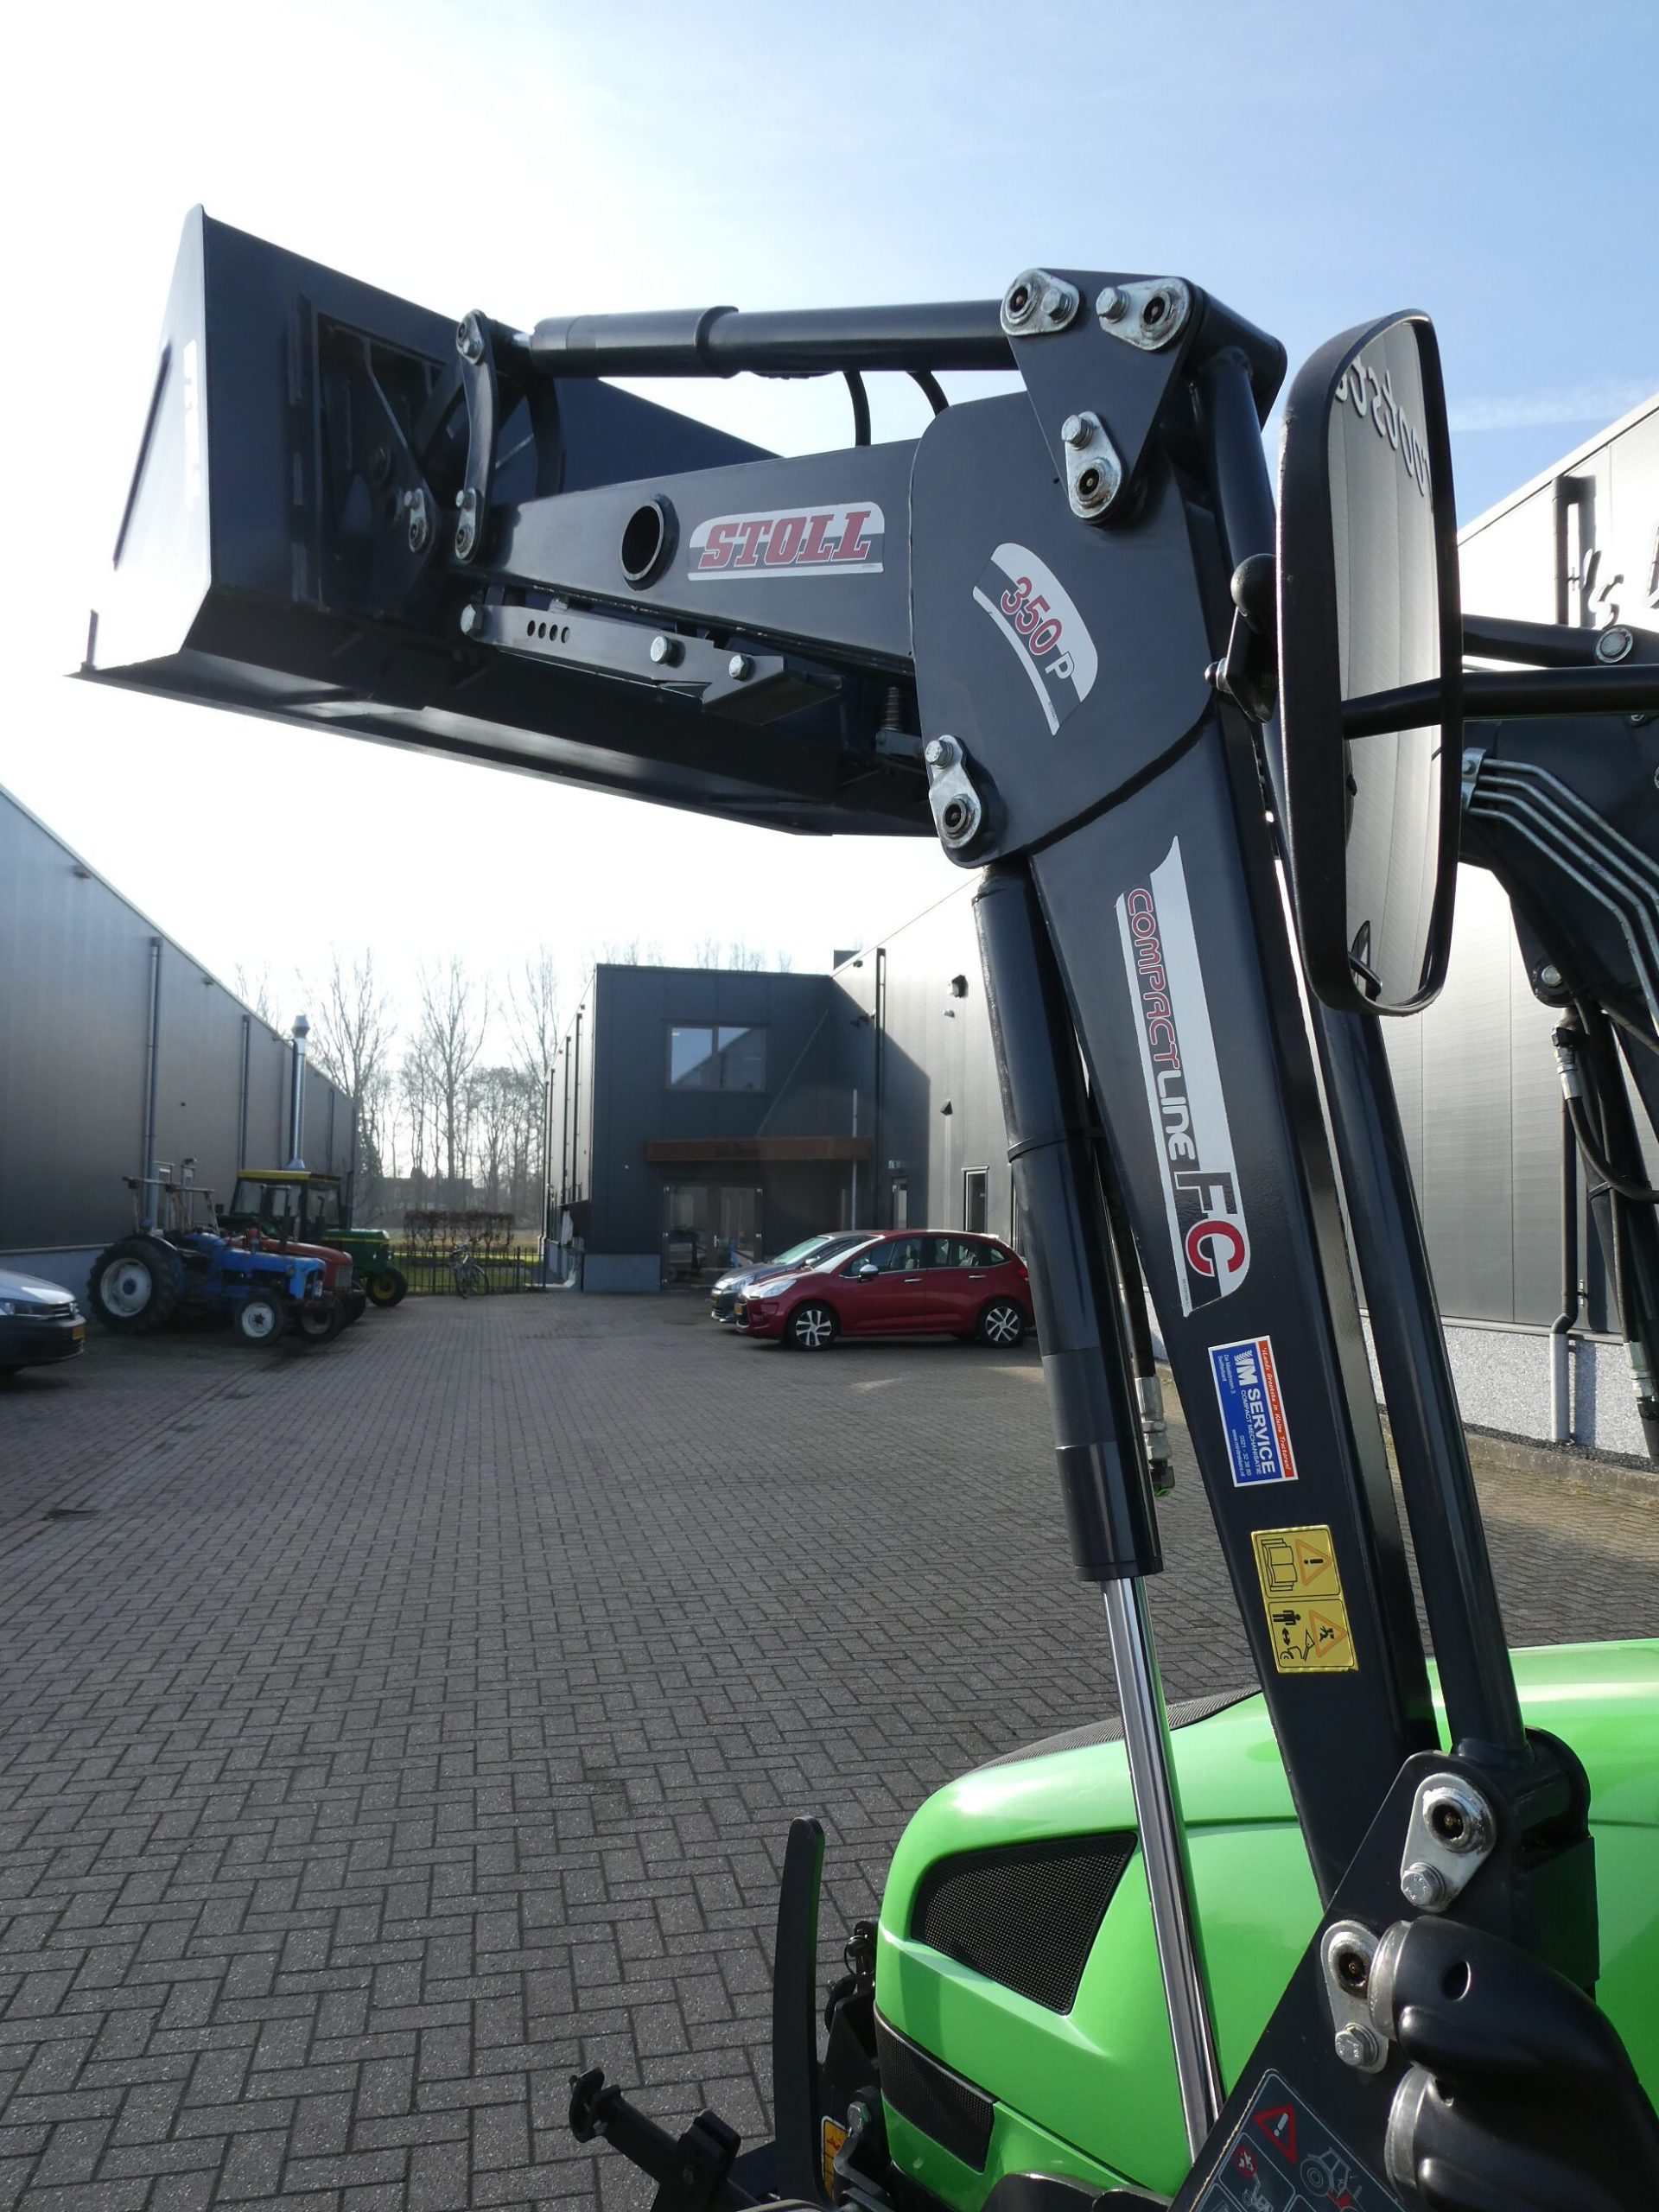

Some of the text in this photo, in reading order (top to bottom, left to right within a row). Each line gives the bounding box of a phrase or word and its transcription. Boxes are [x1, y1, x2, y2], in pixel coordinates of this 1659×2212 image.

[697, 510, 872, 570] STOLL
[1000, 576, 1075, 679] 350 P
[1127, 887, 1247, 1278] COMPACTLINE FC
[1240, 1389, 1262, 1475] COMPACT MECHANISATIE
[1246, 1387, 1275, 1474] SERVICE
[1266, 1372, 1277, 1402] Grootste
[1274, 1413, 1283, 1433] Kleine
[1279, 1435, 1291, 1470] Tractoren!
